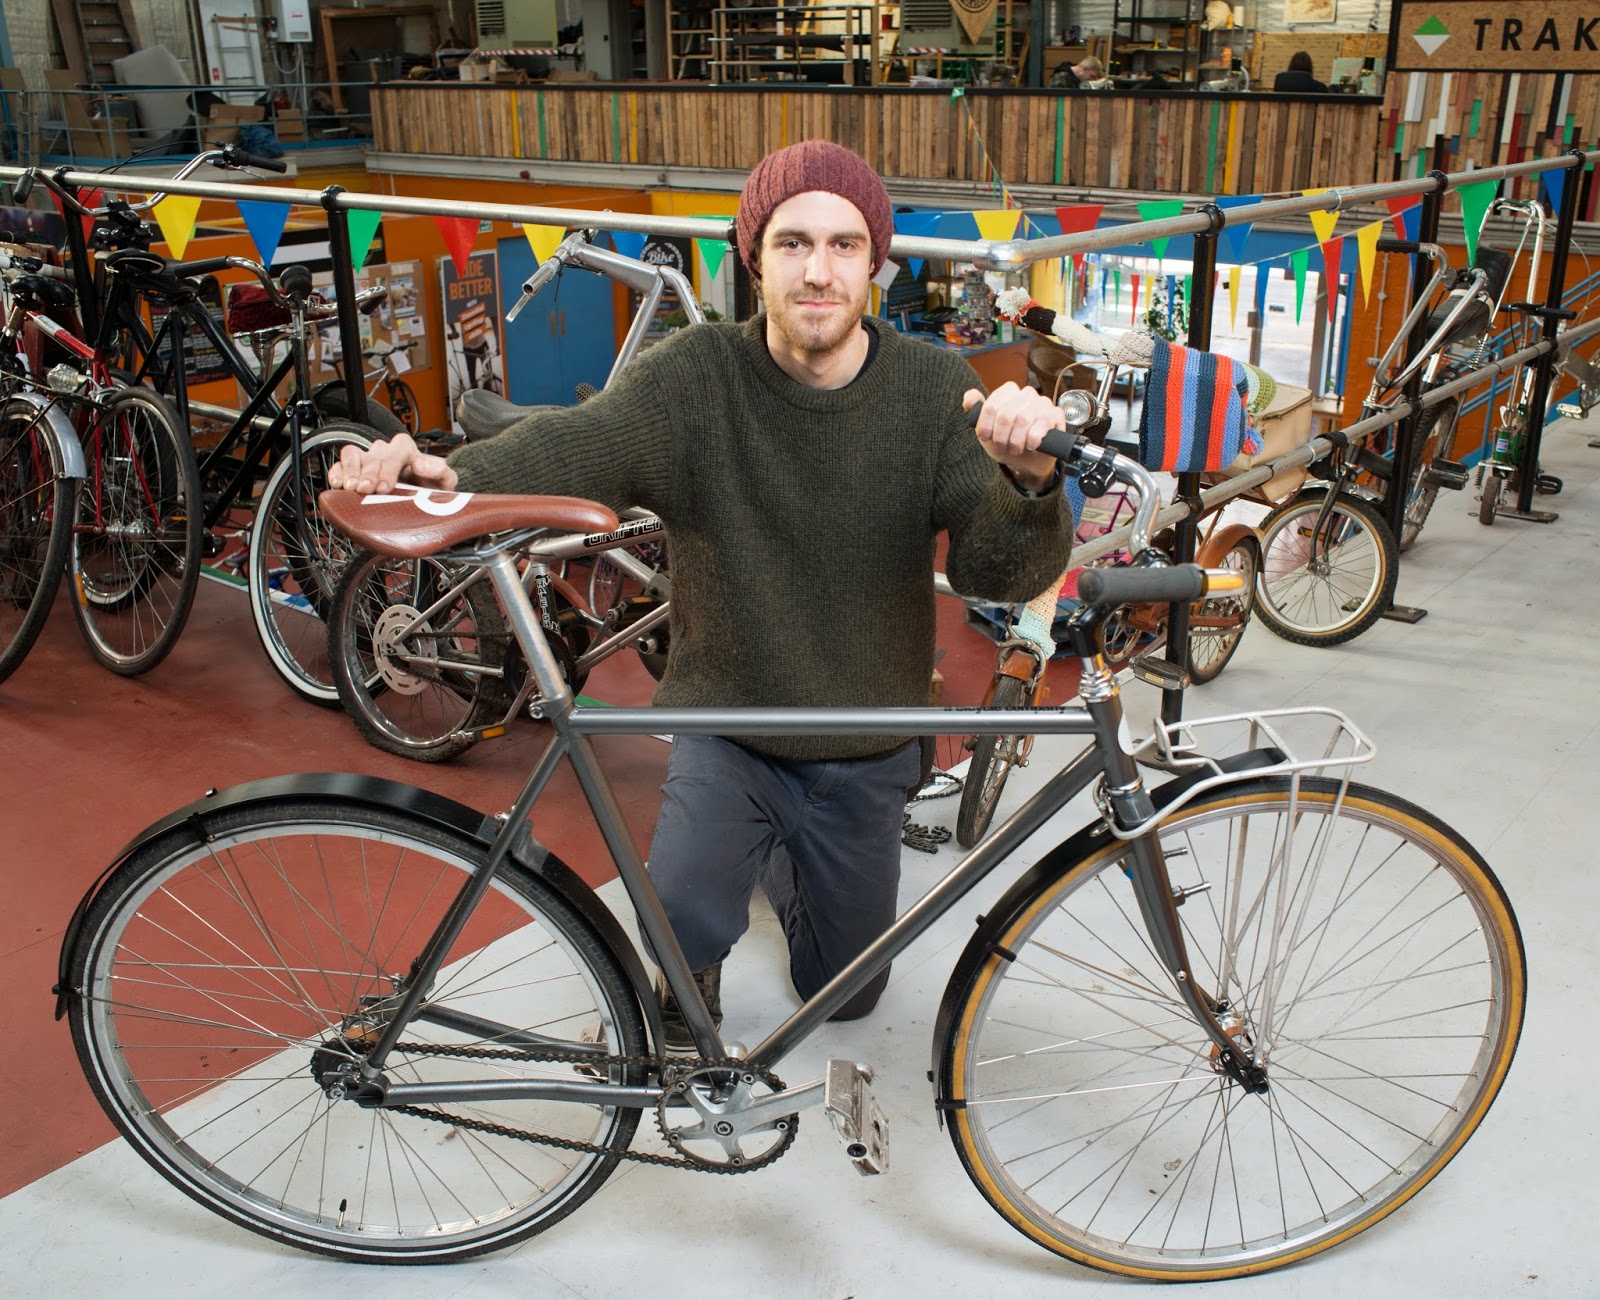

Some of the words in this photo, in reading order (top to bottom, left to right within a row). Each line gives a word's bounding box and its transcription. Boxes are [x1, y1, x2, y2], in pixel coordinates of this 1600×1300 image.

[1473, 17, 1600, 51] TRAK
[647, 246, 675, 264] Bike
[457, 259, 483, 279] IDE
[450, 278, 492, 300] BETTER
